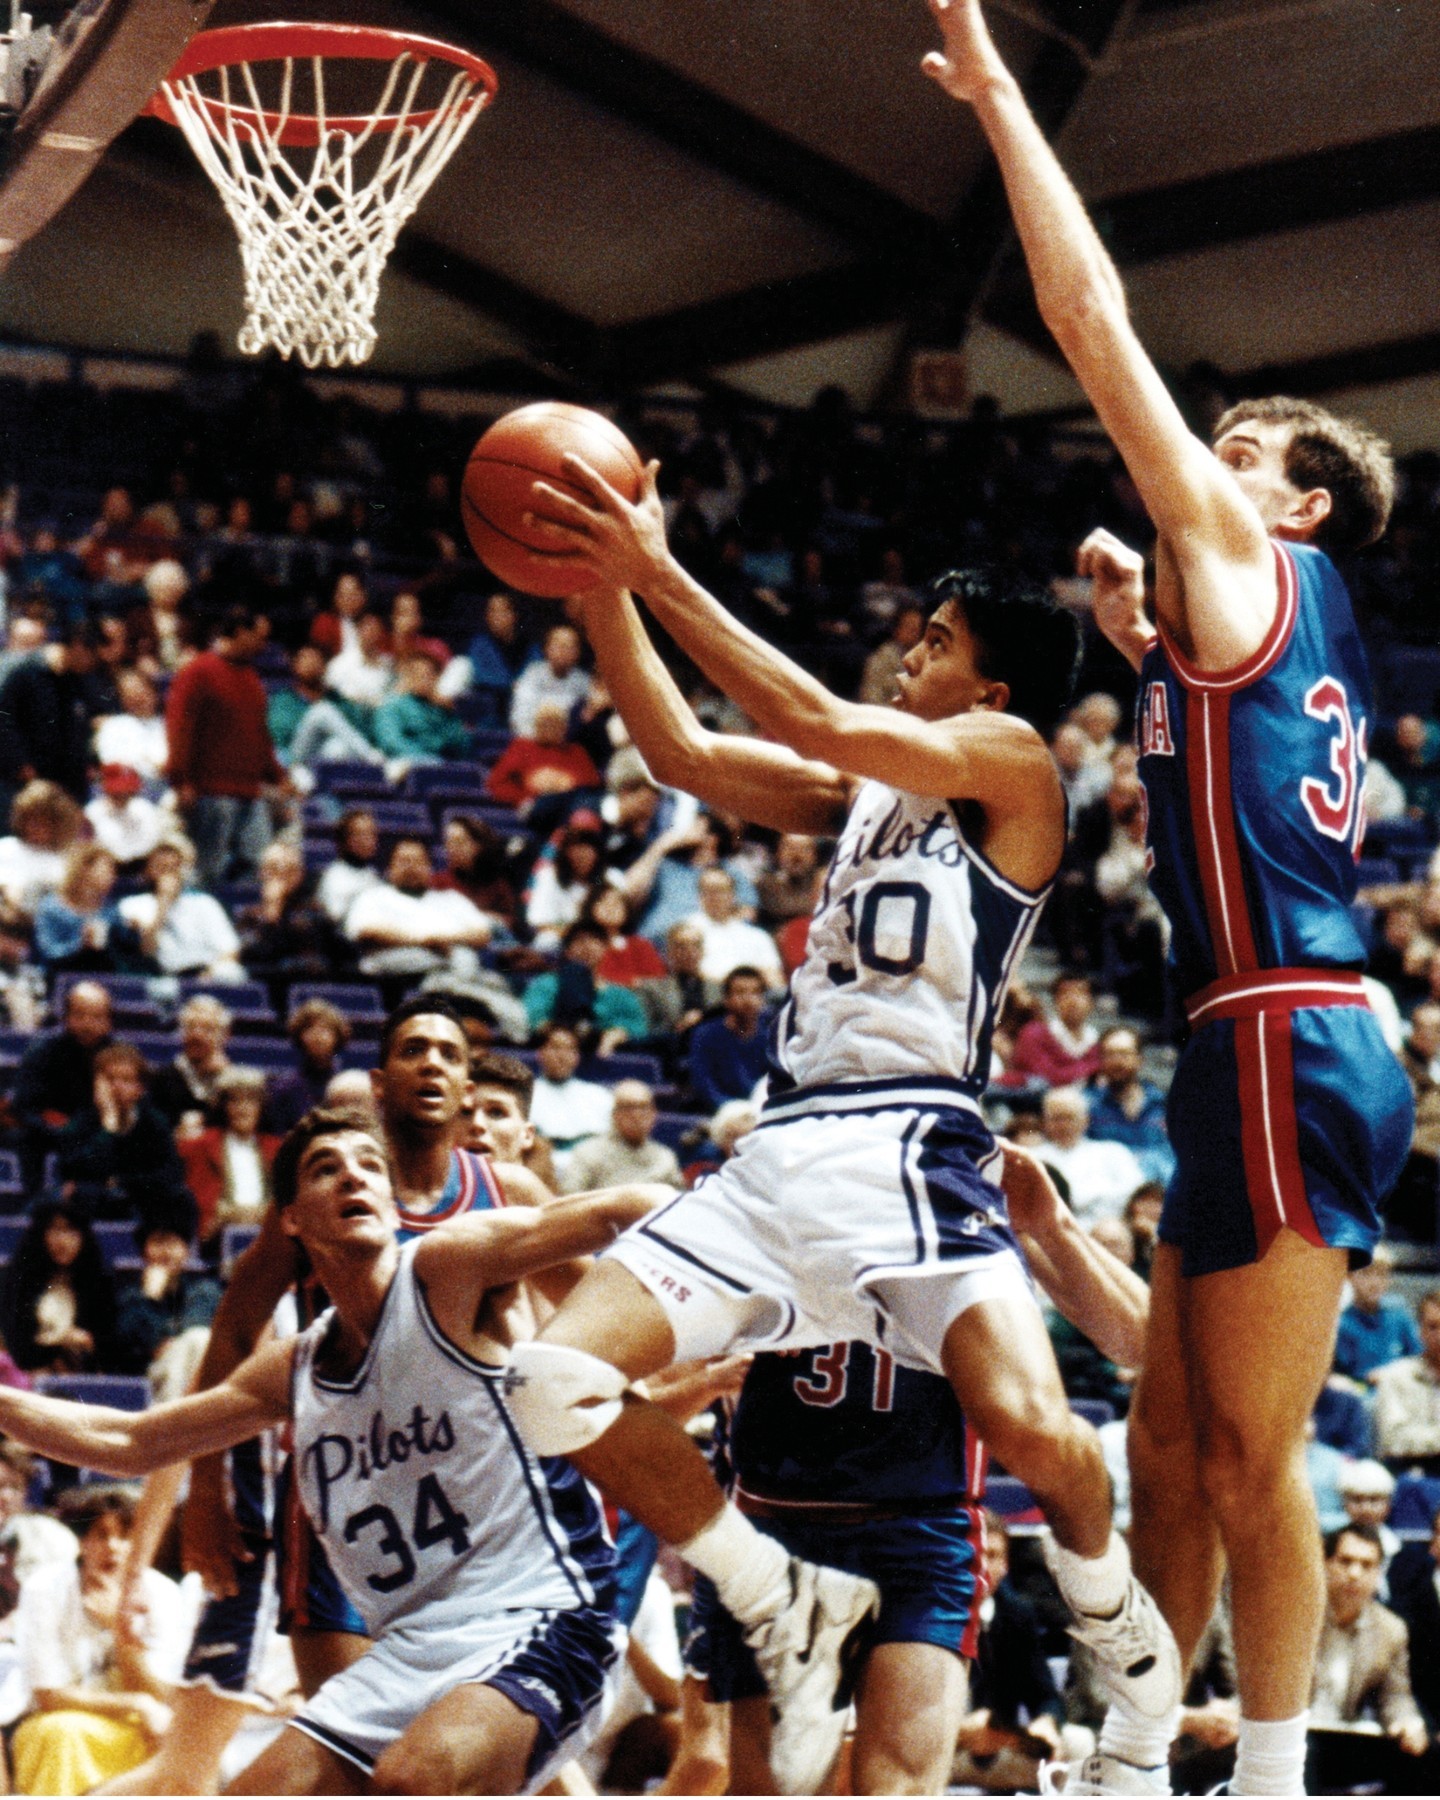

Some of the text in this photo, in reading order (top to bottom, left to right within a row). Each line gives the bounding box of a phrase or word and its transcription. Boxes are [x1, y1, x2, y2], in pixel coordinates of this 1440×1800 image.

[793, 1340, 897, 1412] 31
[301, 1405, 457, 1535] Pilots
[344, 1471, 471, 1594] 34
